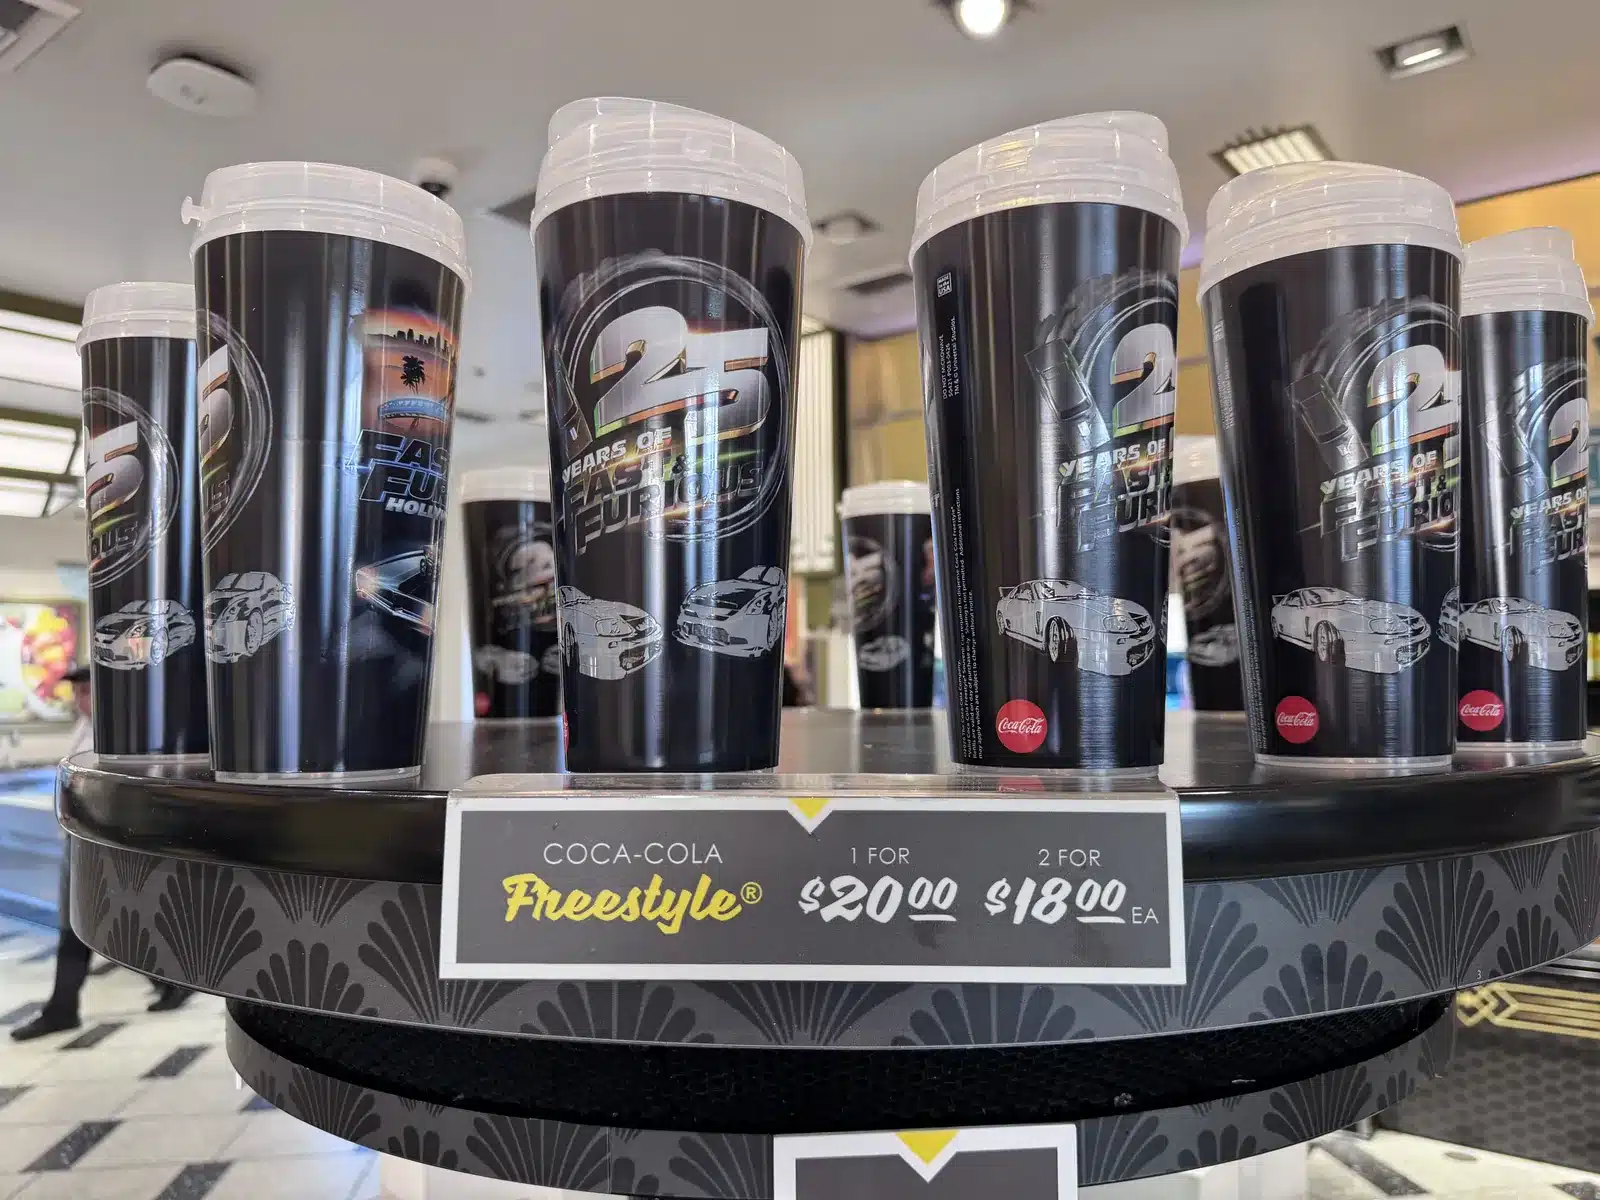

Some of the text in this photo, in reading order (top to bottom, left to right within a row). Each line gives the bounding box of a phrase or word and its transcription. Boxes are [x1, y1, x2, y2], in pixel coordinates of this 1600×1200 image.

[588, 306, 771, 447] 25
[1111, 322, 1175, 440] 2
[562, 426, 672, 484] YEARS OF
[1547, 398, 1588, 488] 2
[1058, 438, 1166, 481] YEARS OF
[1320, 450, 1437, 494] YEARS OF
[574, 460, 764, 556] FURIOUS
[1510, 492, 1573, 519] YEARS
[1277, 711, 1316, 727] Coca-Cola
[1460, 703, 1504, 717] Coca-Cola
[998, 717, 1044, 734] Coca-Cola
[543, 842, 724, 865] COCA-COLA
[850, 847, 910, 865] 1 FOR
[1038, 849, 1101, 867] 2 FOR
[1131, 907, 1159, 924] EA
